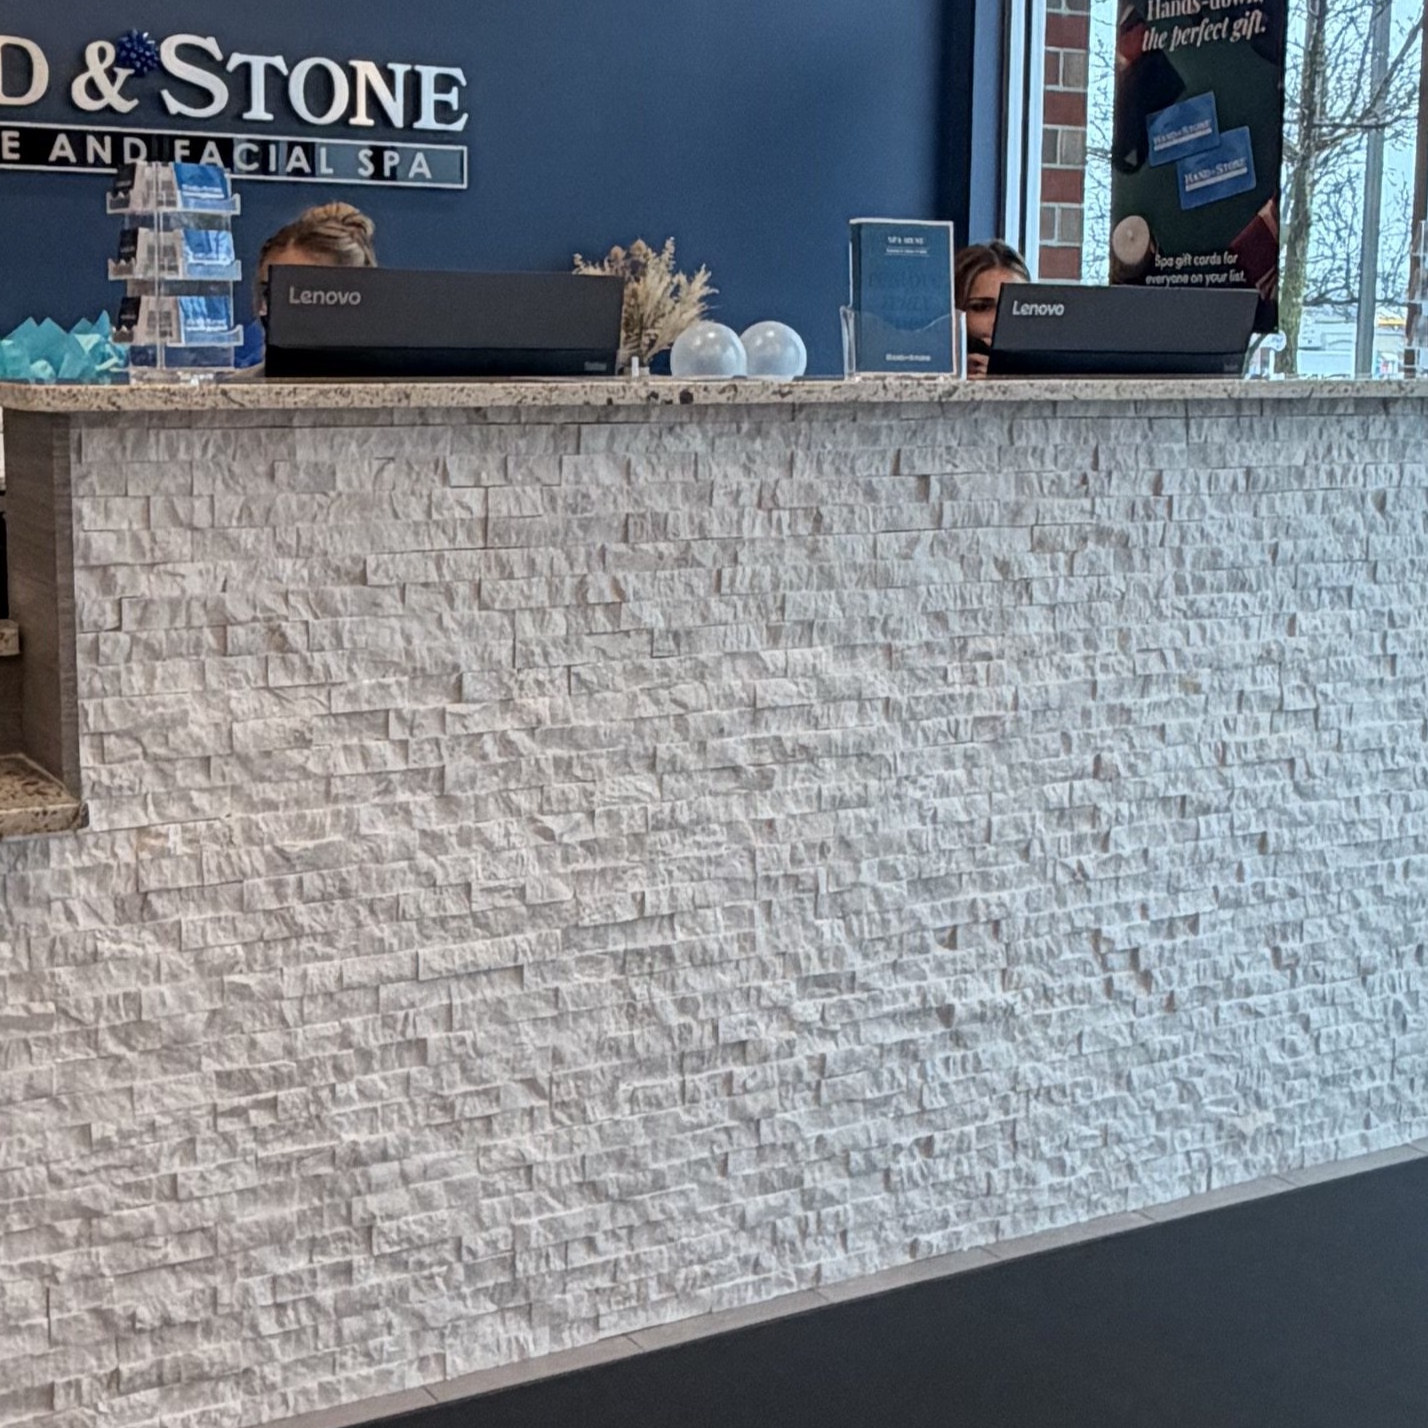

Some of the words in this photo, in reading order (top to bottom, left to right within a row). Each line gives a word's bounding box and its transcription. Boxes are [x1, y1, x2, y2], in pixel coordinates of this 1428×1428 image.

[1142, 26, 1168, 52] the
[1169, 17, 1230, 52] perfect
[1229, 9, 1266, 43] gift.
[71, 39, 140, 113] &
[159, 33, 469, 133] STONE
[49, 133, 148, 163] AND
[174, 139, 335, 176] FACIAL
[357, 148, 433, 180] SPA
[1155, 254, 1174, 270] Spa
[1175, 253, 1192, 270] gift
[1193, 252, 1222, 266] cards
[1224, 251, 1238, 265] for
[1145, 274, 1189, 288] everyone
[1190, 274, 1203, 283] on
[1205, 273, 1228, 287] your
[1229, 269, 1247, 283] list.
[288, 286, 362, 306] Lenovo
[1012, 300, 1065, 316] Lenovo
